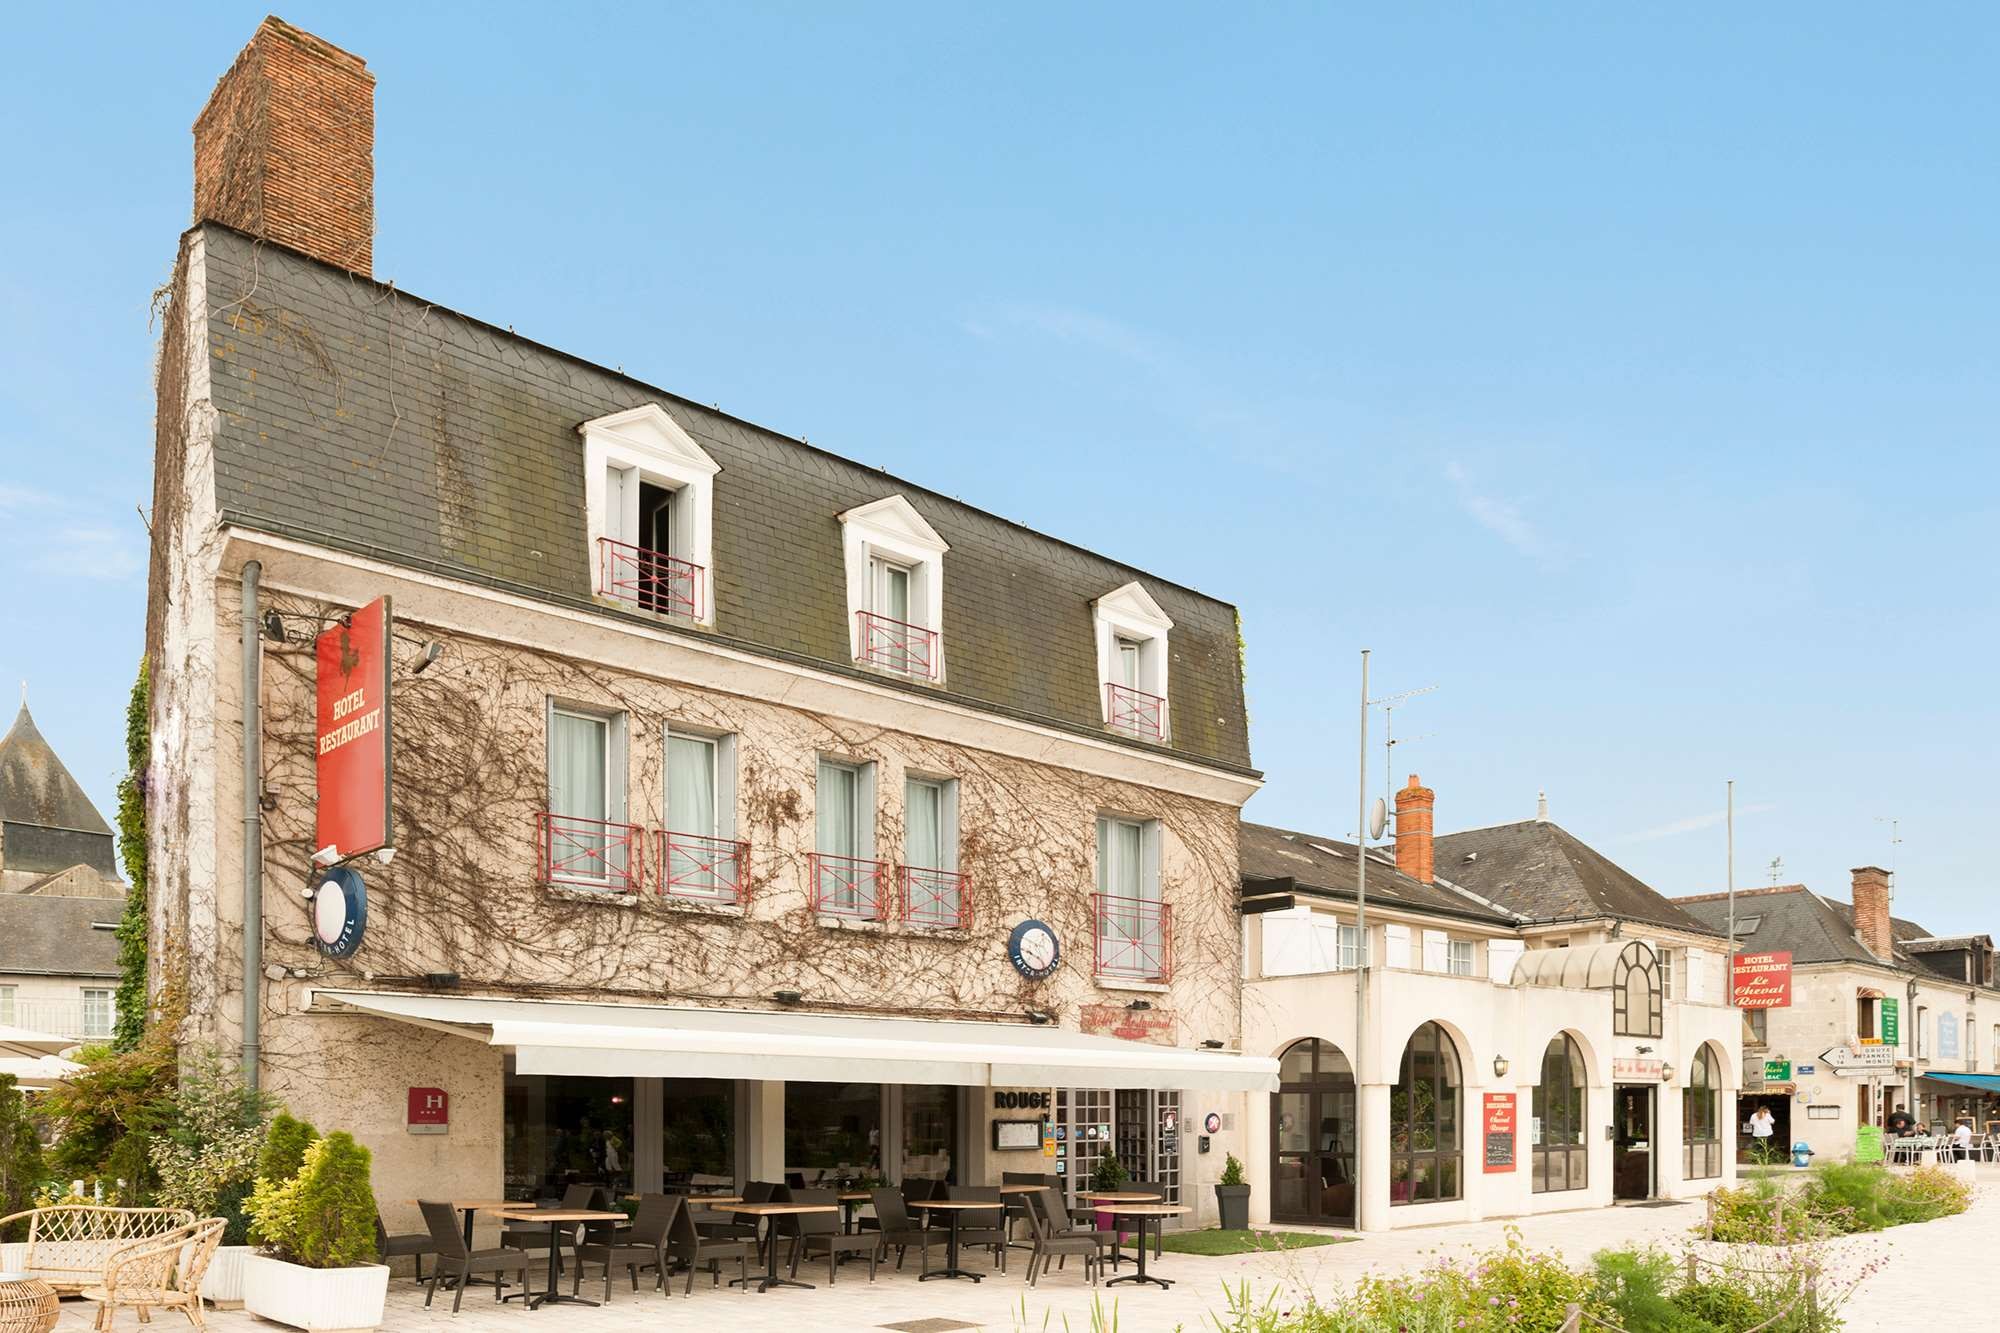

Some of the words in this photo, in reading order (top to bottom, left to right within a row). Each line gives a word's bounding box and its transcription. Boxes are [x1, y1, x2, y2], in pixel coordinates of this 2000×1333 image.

[333, 688, 365, 720] HOTEL
[320, 707, 380, 755] RESTAURANT
[1744, 956, 1774, 965] HOTEL
[1749, 976, 1769, 986] Le
[1734, 984, 1785, 996] Cheval
[1734, 996, 1782, 1007] Rouge
[426, 1095, 443, 1109] H
[994, 1091, 1051, 1109] ROUGE
